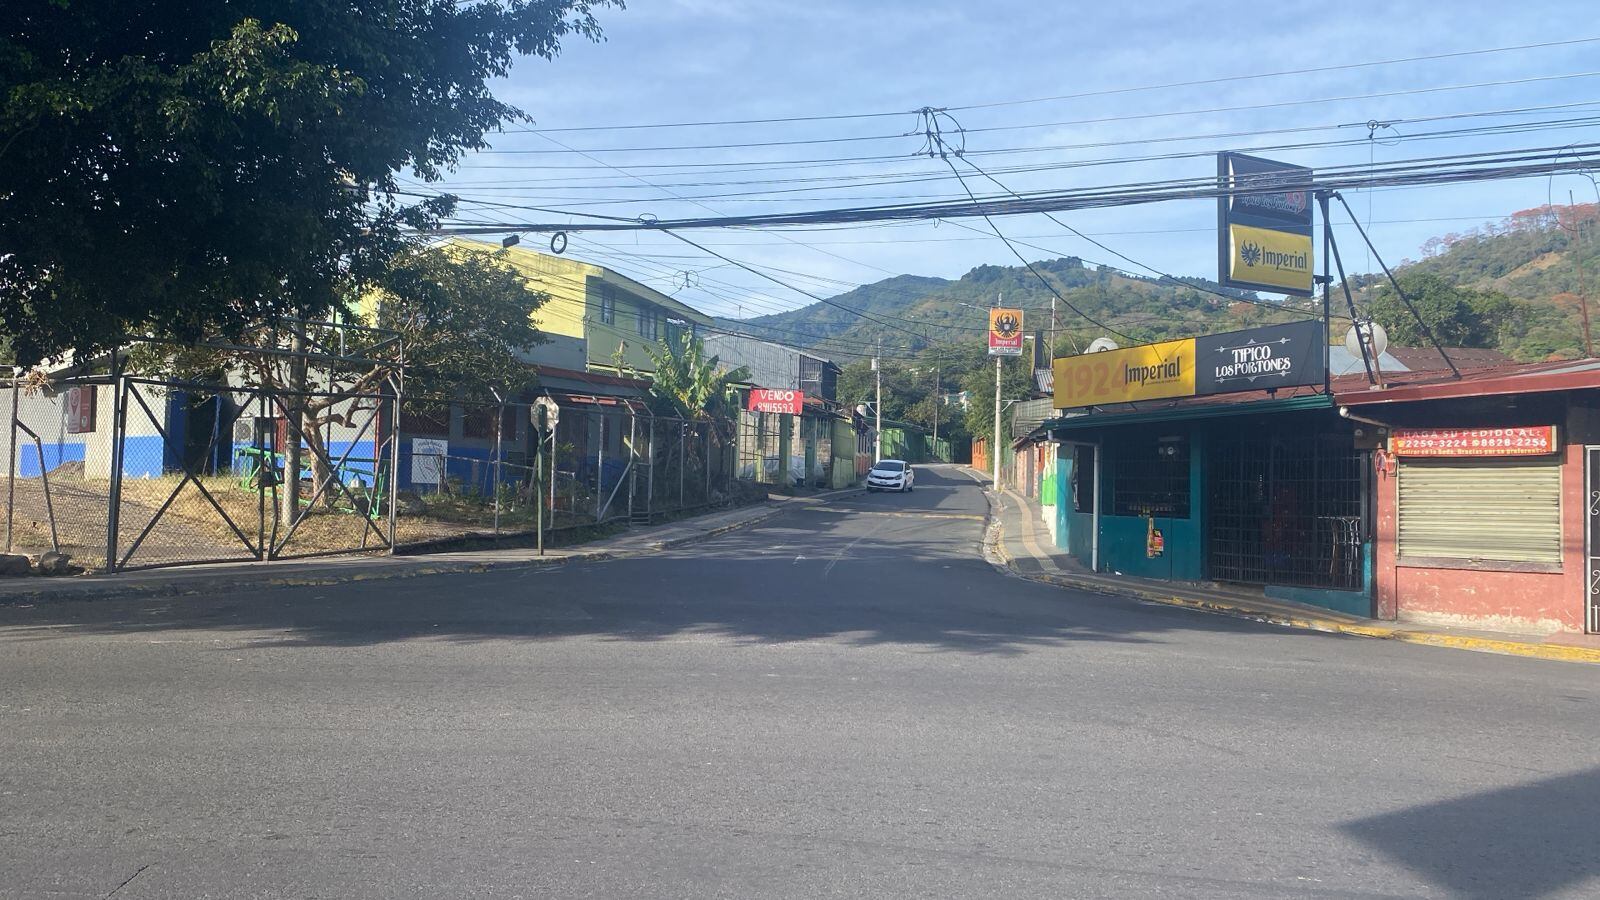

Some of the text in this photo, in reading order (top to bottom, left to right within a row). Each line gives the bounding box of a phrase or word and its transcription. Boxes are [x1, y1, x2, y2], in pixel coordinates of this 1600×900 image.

[1262, 246, 1307, 270] Imperial
[1231, 345, 1271, 363] TIPICO
[1215, 357, 1291, 378] LOS PORTONES
[1063, 356, 1182, 400] 1924 Imperial
[760, 390, 794, 402] VENDO
[1443, 430, 1458, 438] SU
[1463, 429, 1514, 438] PEDIDO
[1406, 439, 1468, 448] 2259-3224
